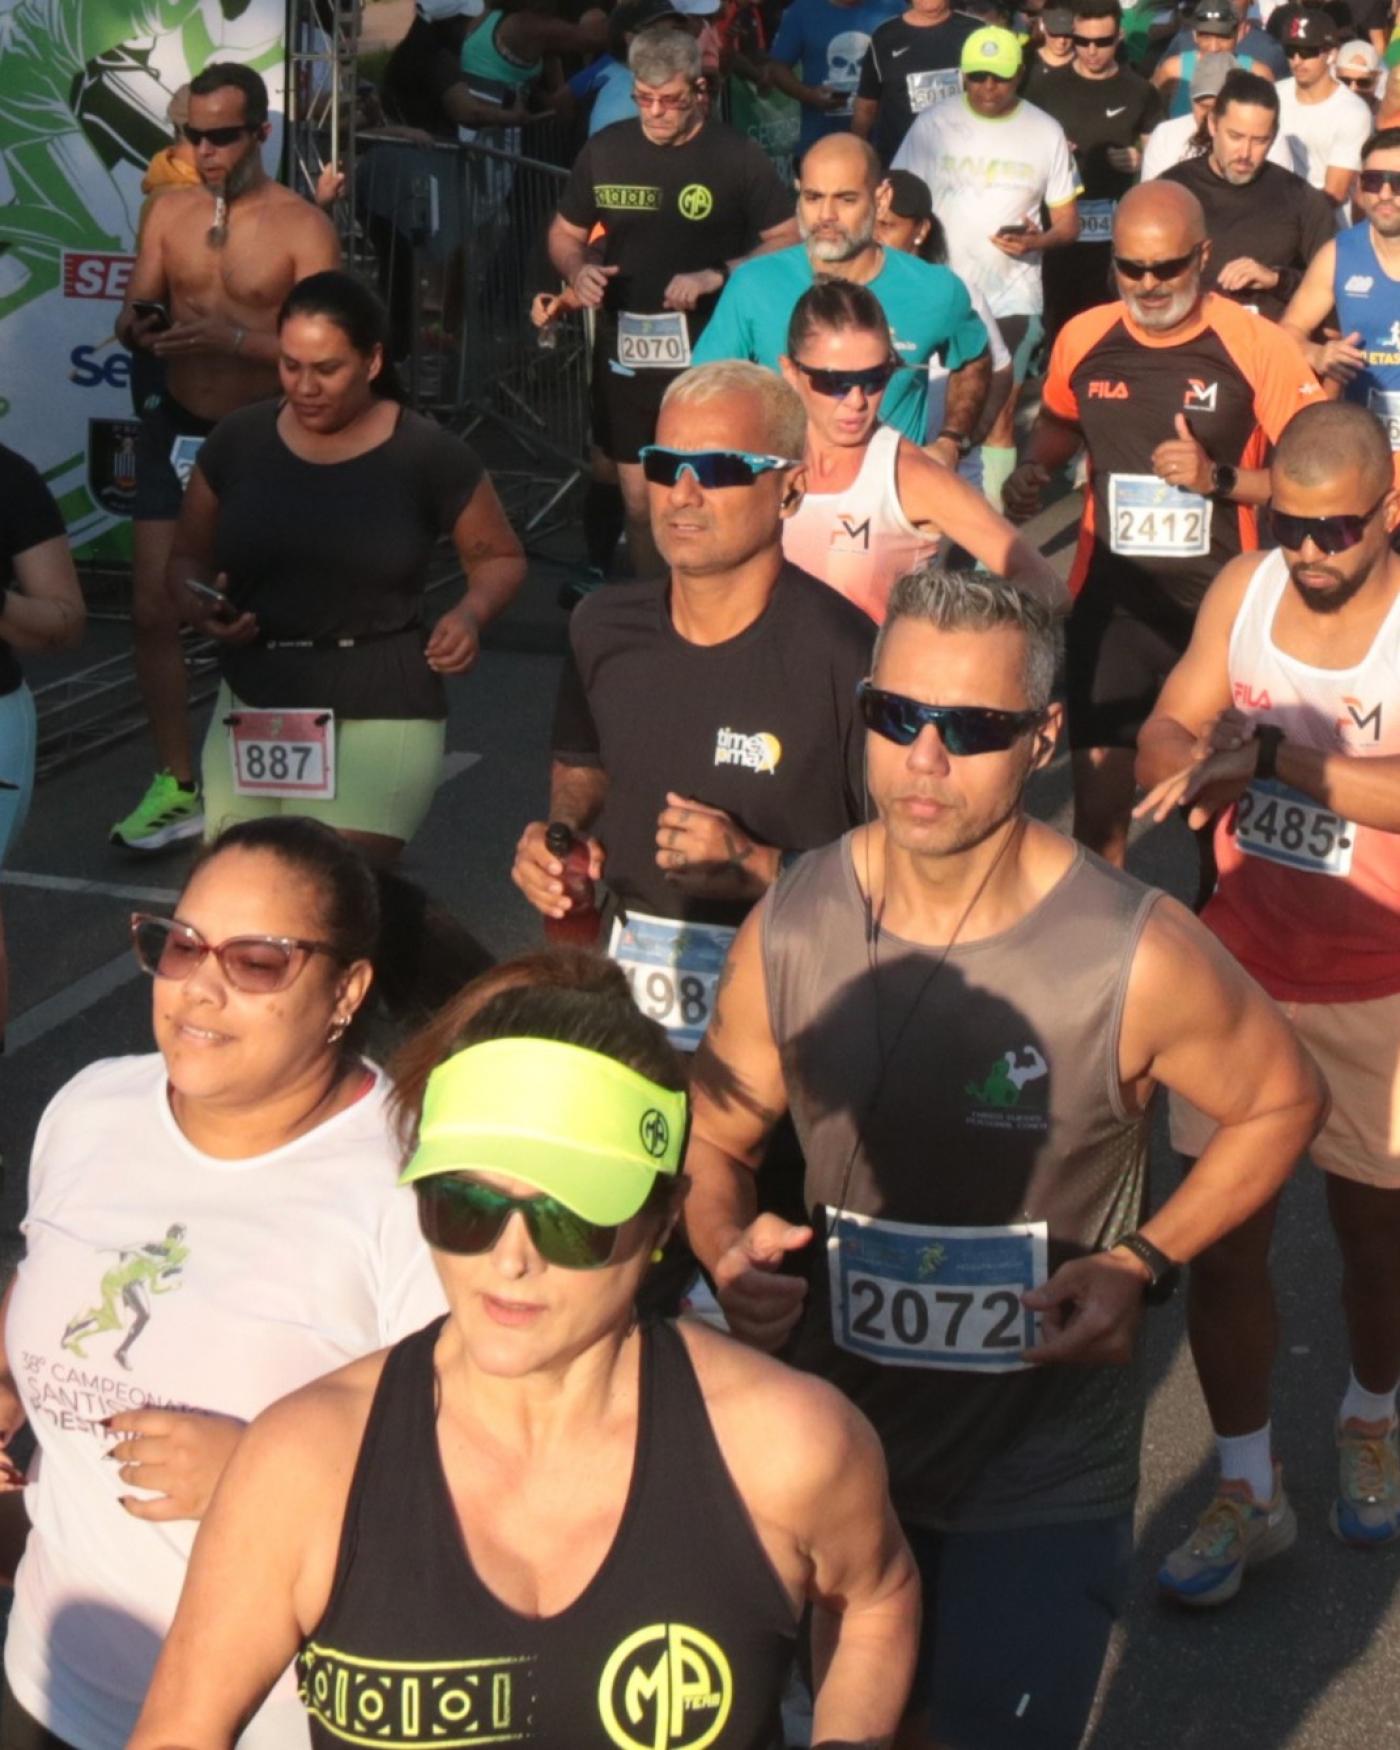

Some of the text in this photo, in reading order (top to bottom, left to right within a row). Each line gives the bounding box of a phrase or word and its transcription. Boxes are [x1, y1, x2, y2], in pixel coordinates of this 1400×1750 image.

[624, 337, 679, 359] 2070
[1088, 381, 1129, 399] FILA
[1119, 510, 1200, 542] 2412
[1234, 682, 1272, 710] FILA
[246, 745, 312, 781] 887
[1237, 791, 1338, 858] 2485
[626, 967, 708, 1025] 98
[851, 1279, 1021, 1348] 2072
